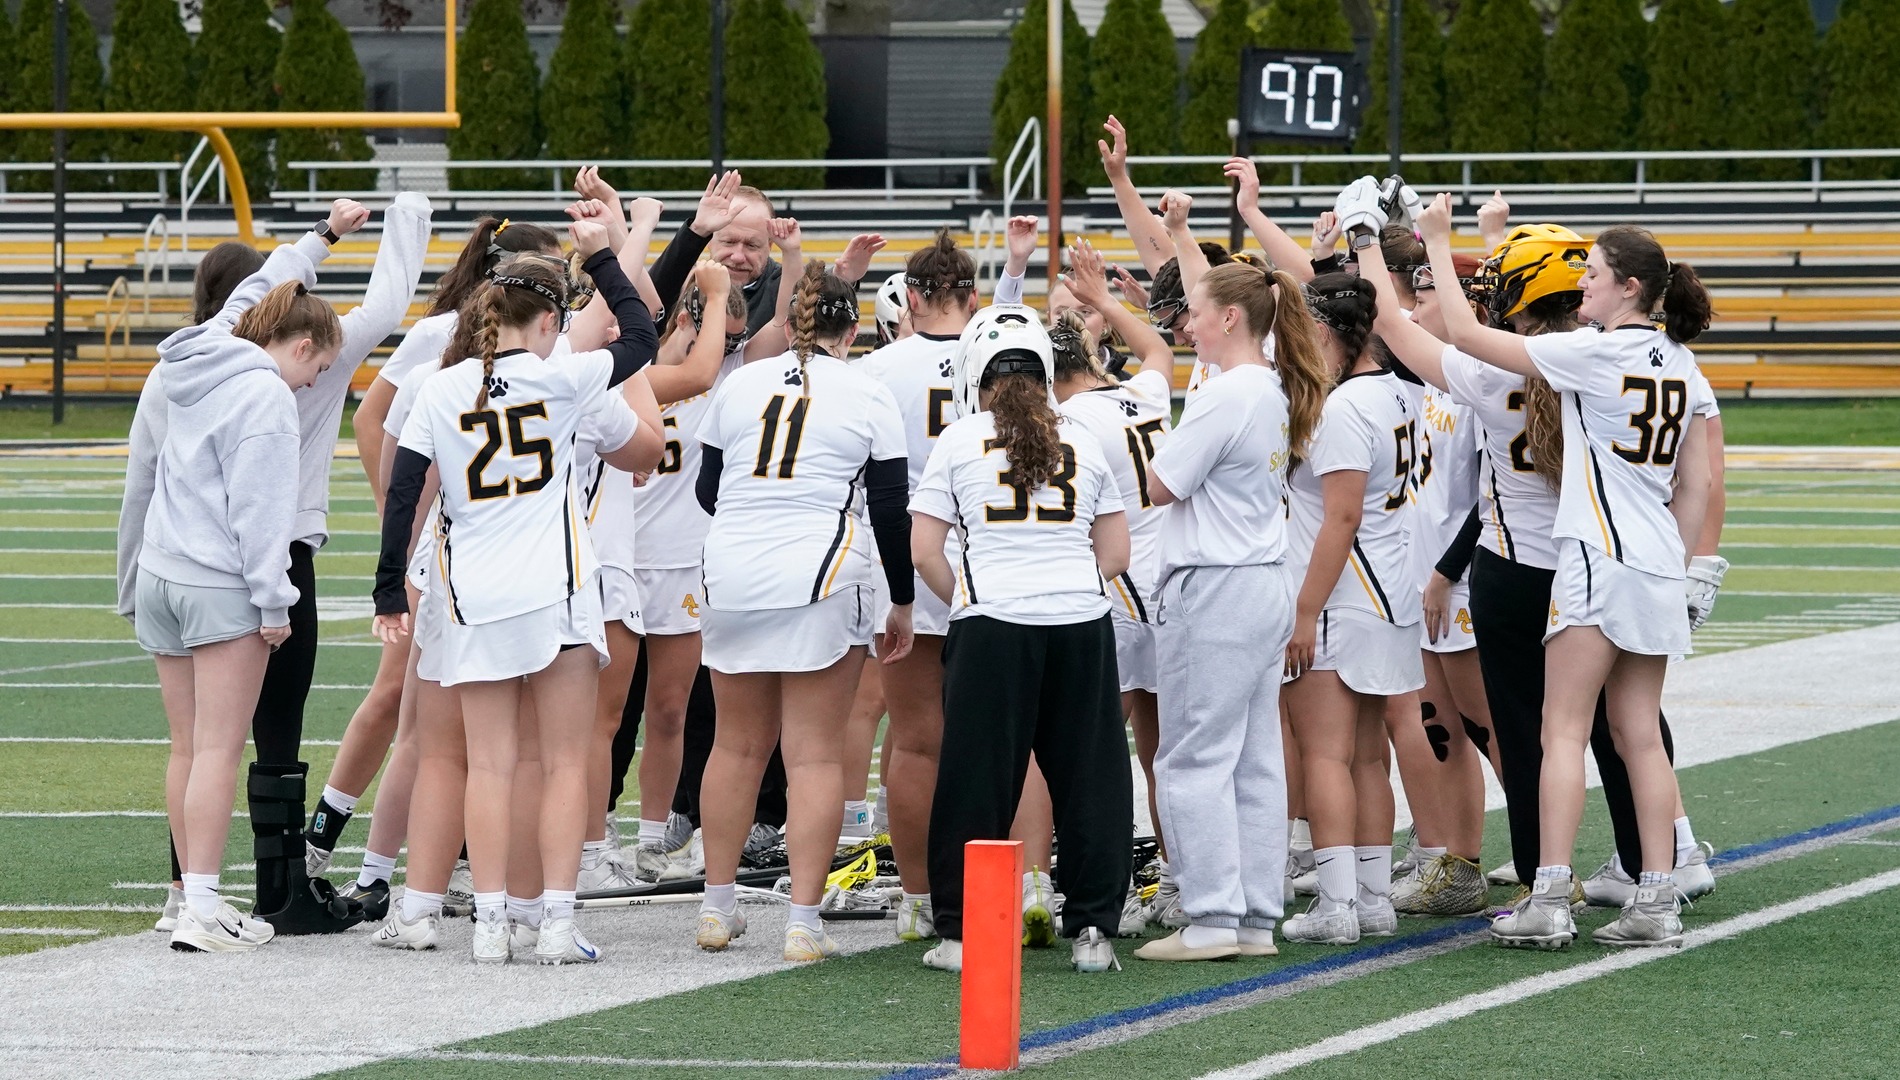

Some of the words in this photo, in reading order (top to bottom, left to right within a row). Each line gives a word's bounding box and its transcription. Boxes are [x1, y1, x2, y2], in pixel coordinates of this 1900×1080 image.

[1261, 62, 1343, 131] 90
[534, 284, 558, 302] STX
[907, 277, 921, 286] STX
[1335, 290, 1359, 299] STX
[459, 400, 555, 502] 25
[752, 394, 812, 479] 11
[1610, 373, 1687, 467] 38
[982, 438, 1077, 524] 33
